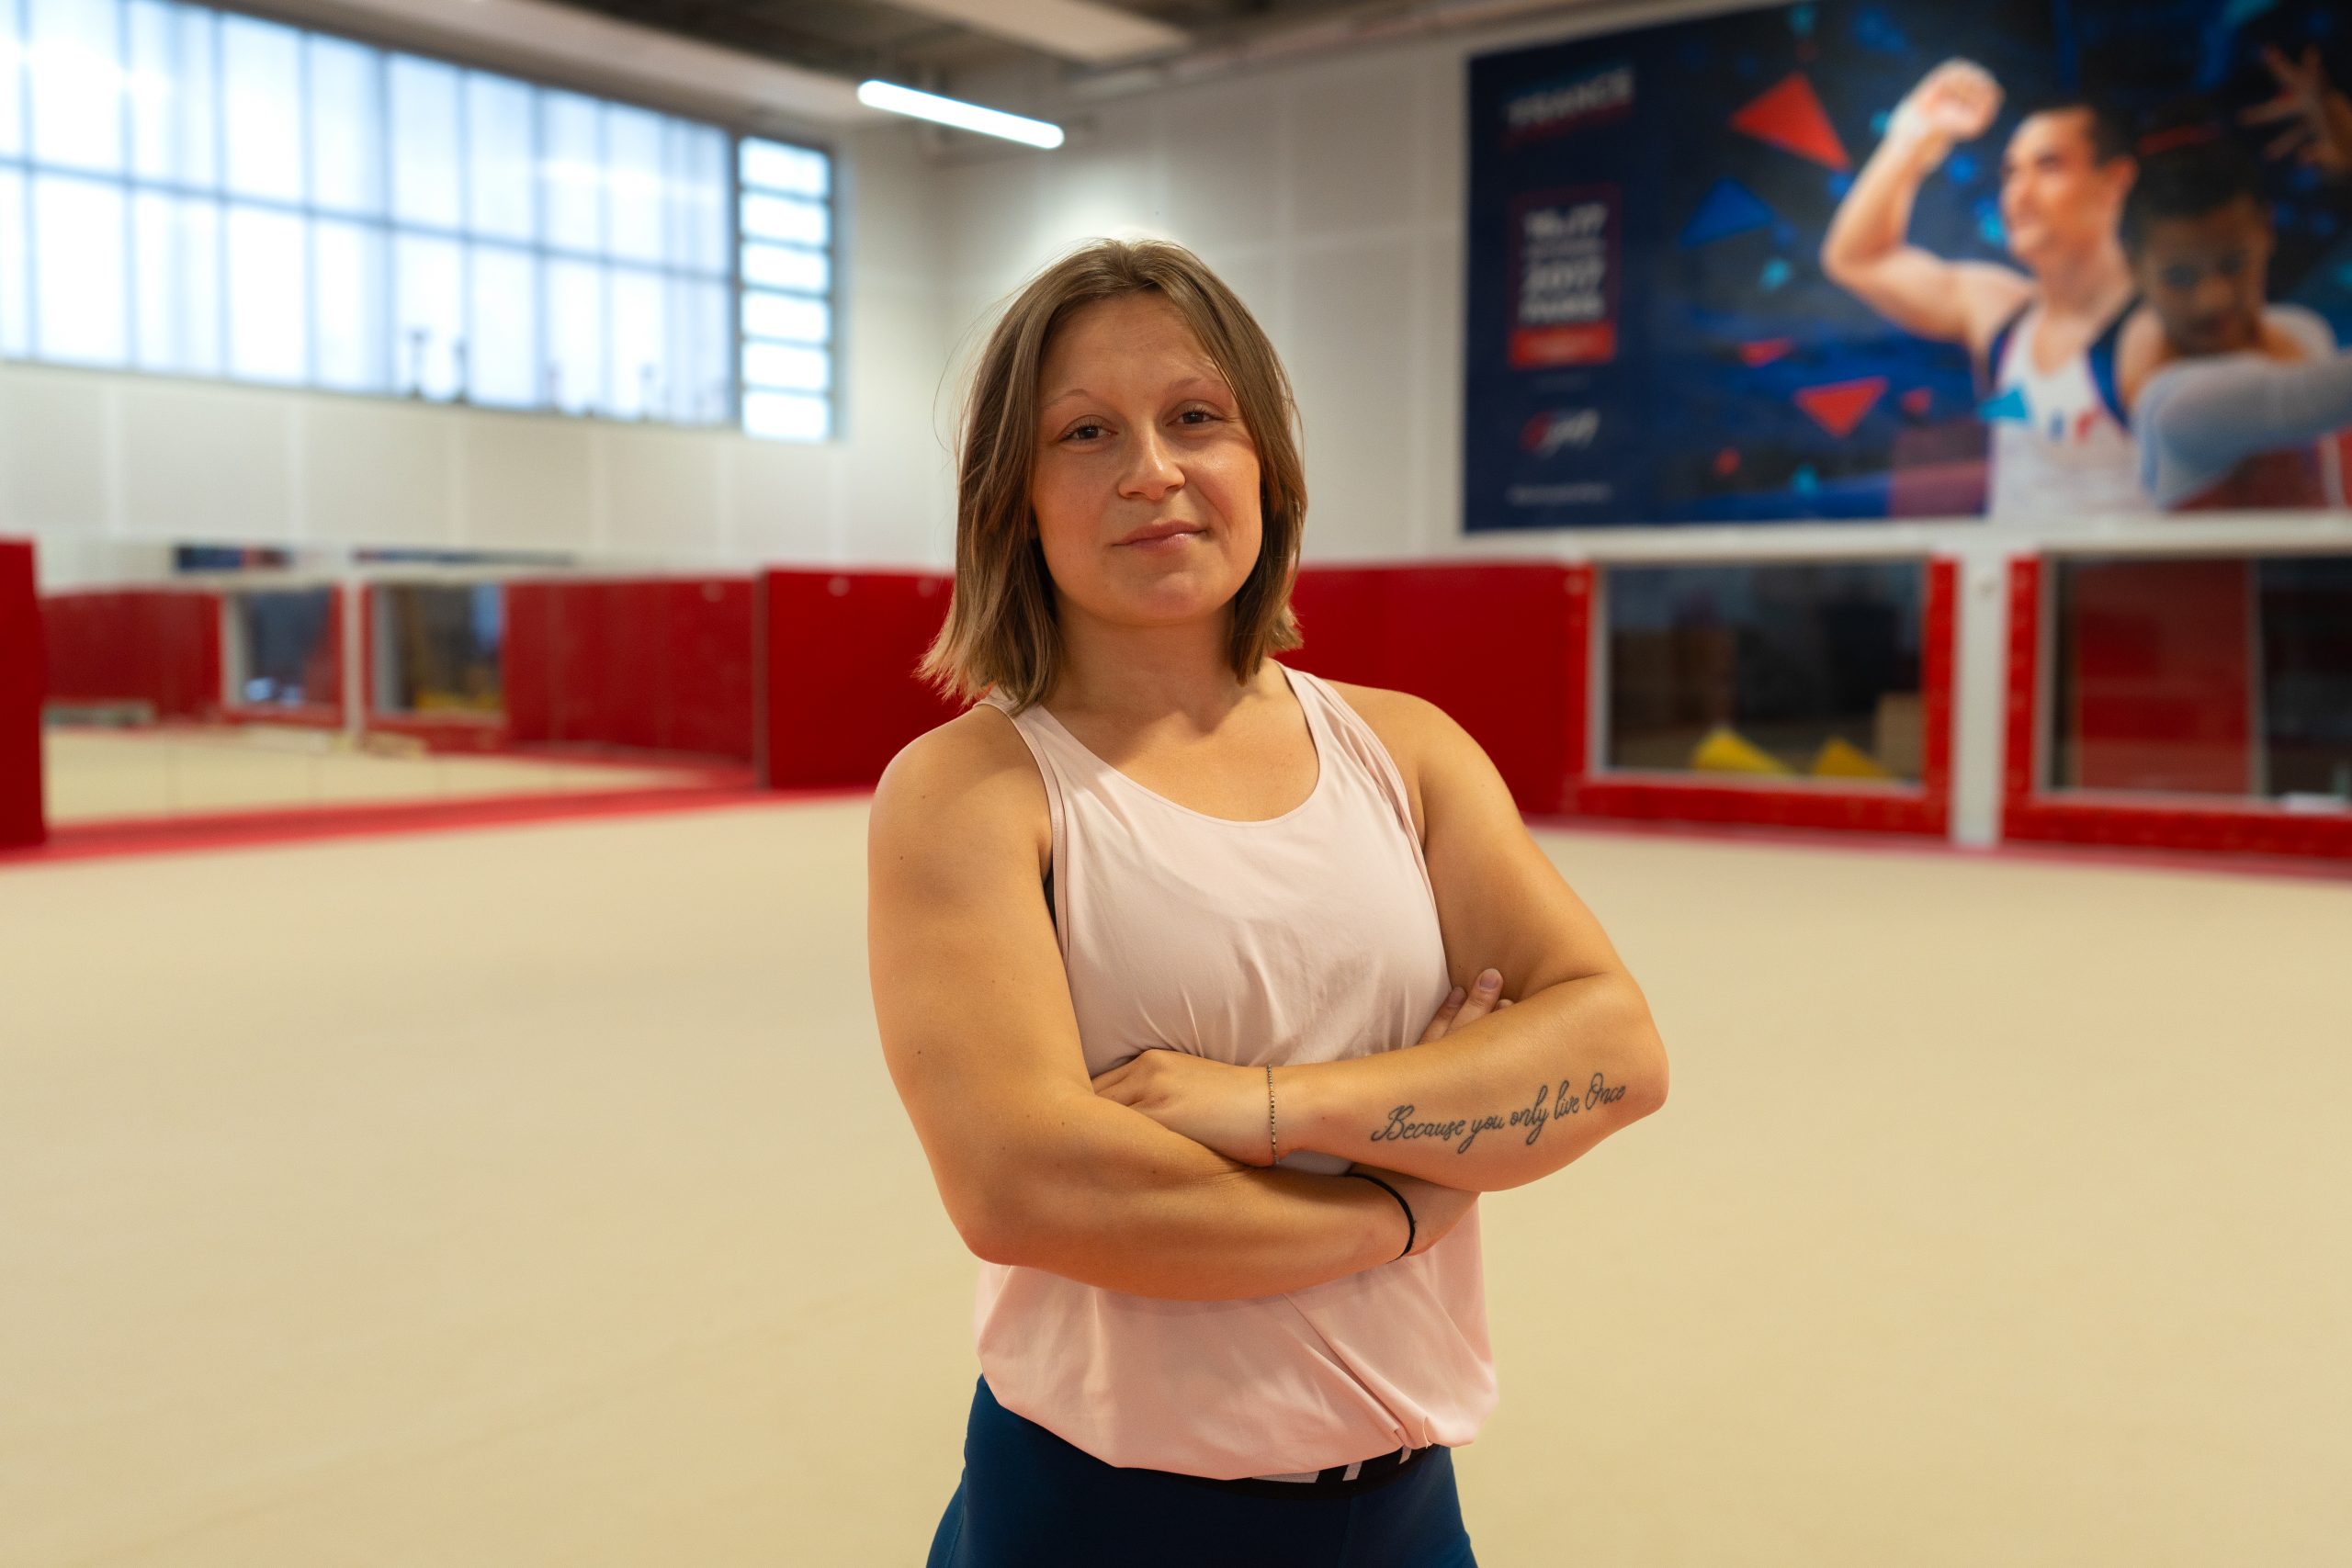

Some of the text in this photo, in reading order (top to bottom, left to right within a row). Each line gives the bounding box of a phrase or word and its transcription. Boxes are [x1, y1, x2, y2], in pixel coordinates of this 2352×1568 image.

[1371, 1072, 1626, 1154] Because you only live Once
